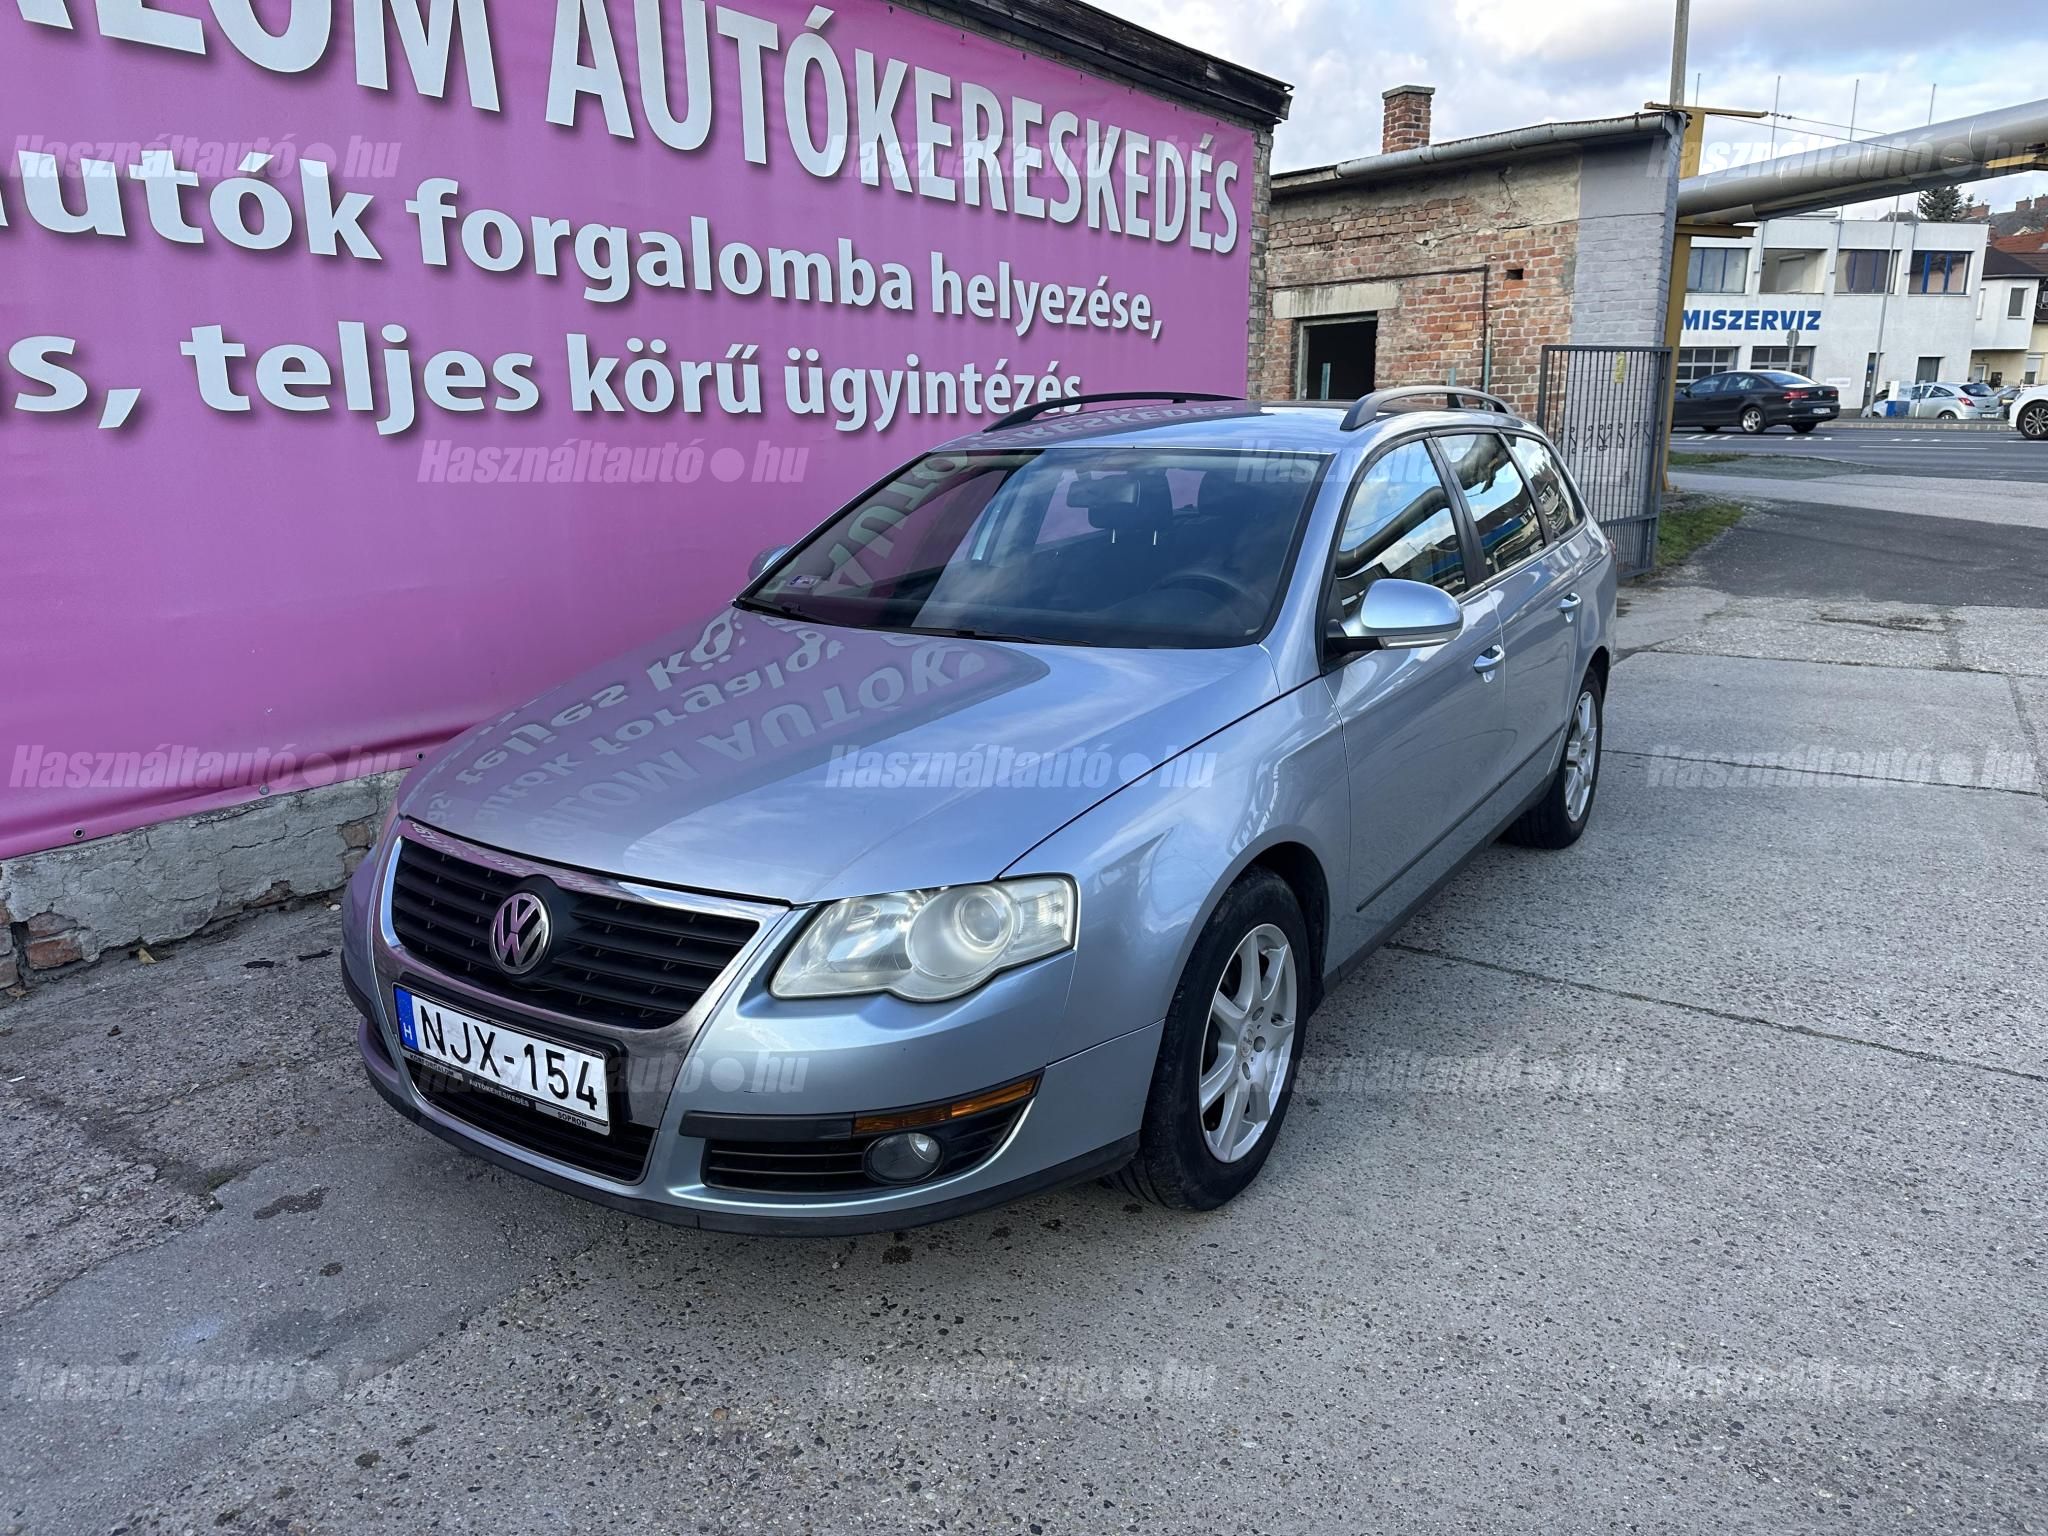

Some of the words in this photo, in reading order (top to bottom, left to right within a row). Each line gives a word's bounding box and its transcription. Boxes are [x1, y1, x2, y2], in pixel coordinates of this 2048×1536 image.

[545, 0, 1239, 255] AUTÓKERESKEDÉS
[0, 149, 382, 260] utók
[405, 178, 912, 311] forgalomba
[931, 251, 1162, 340] helyezése,
[180, 321, 539, 435] teljes
[566, 333, 762, 414] körű
[784, 348, 1082, 432] ügyintézés
[403, 1022, 414, 1041] H
[420, 1005, 598, 1111] NJX-154
[557, 1111, 587, 1127] SOPRON
